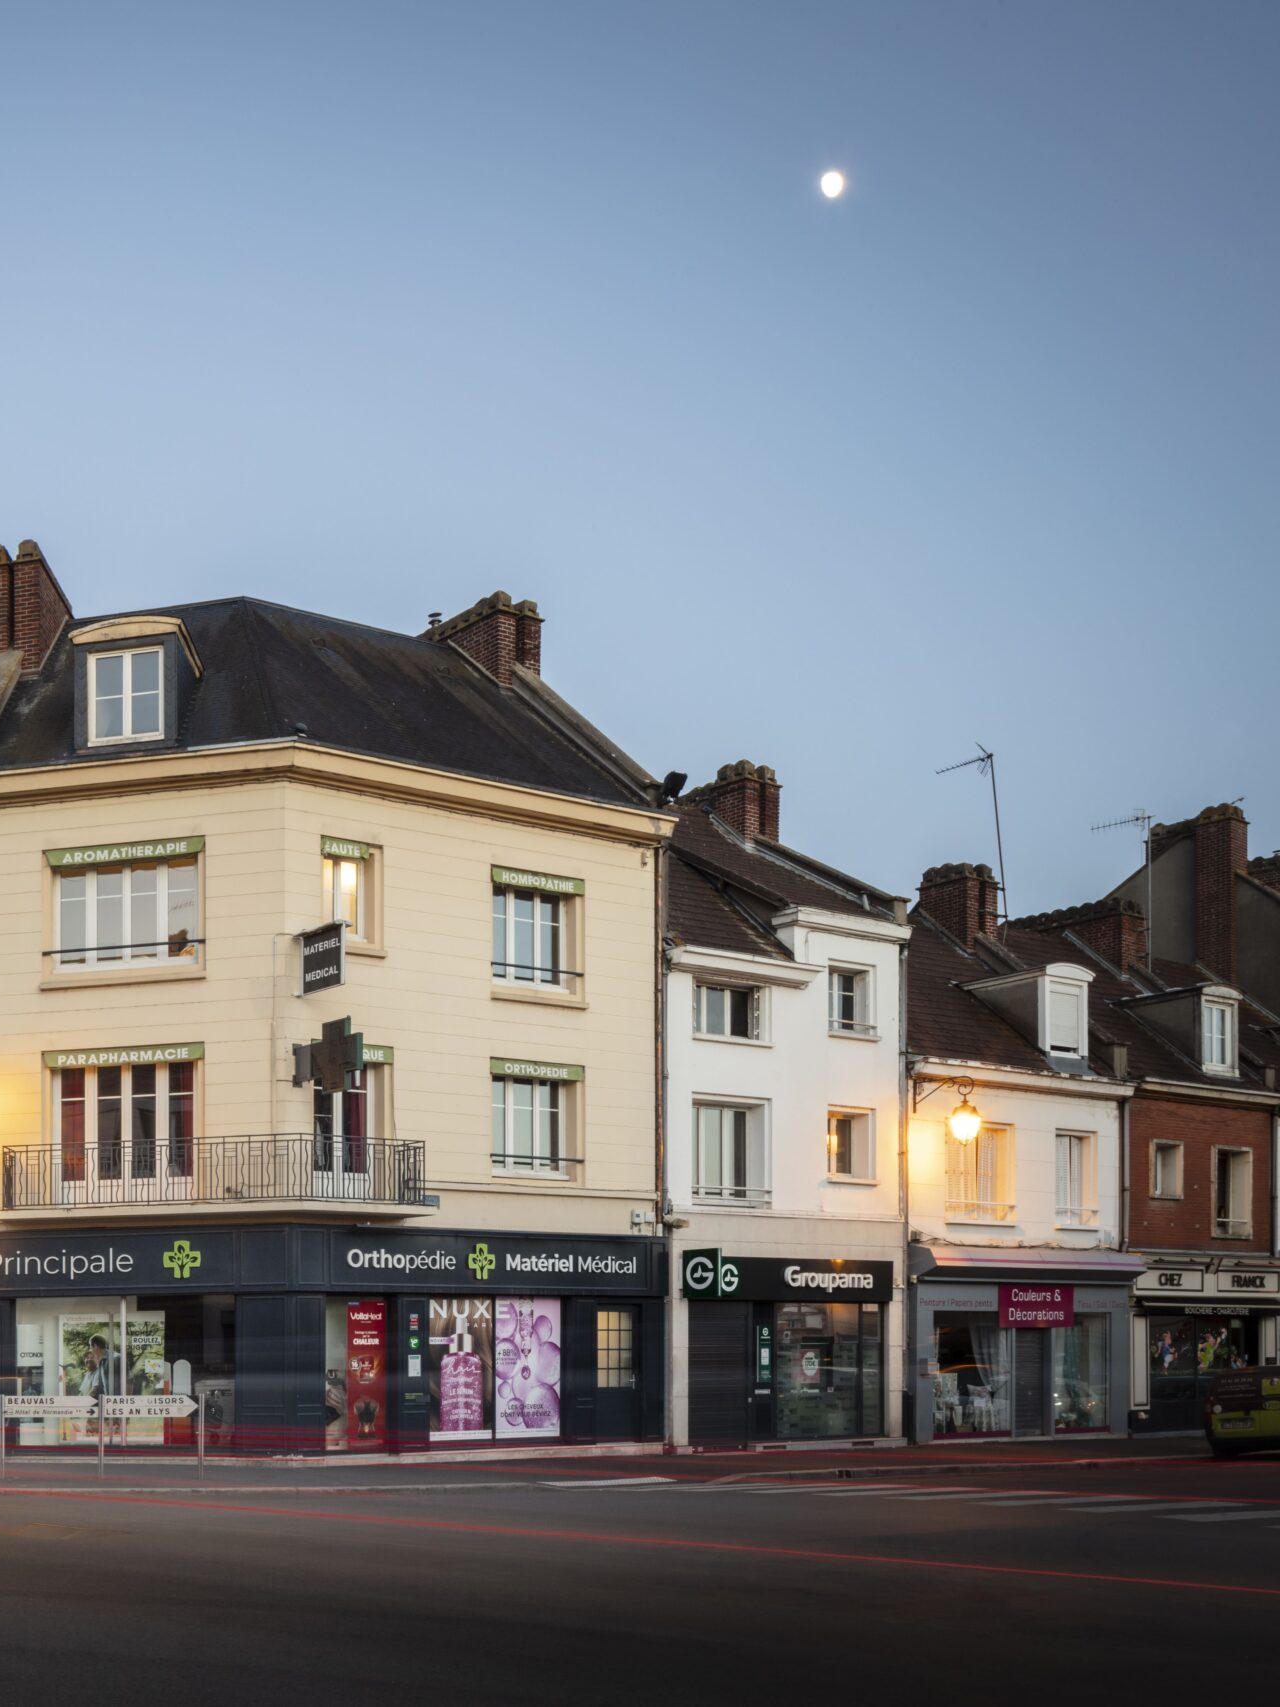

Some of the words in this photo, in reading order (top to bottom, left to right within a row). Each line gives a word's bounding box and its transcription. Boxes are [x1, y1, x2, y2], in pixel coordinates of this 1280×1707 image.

[62, 842, 187, 864] AROMATHERAPIE
[304, 938, 340, 956] MATERIEL
[306, 965, 338, 982] MEDICAL
[57, 1048, 188, 1065] PARAPHARMACIE
[505, 1063, 568, 1078] ORTHOPEDIE
[347, 1248, 456, 1274] Orthopédie
[505, 1253, 573, 1272] Matériel
[578, 1255, 636, 1274] Médical
[784, 1265, 873, 1293] Groupama
[1158, 1273, 1183, 1286] CHEZ
[1231, 1275, 1265, 1288] FRANCK
[1011, 1288, 1051, 1301] Couleurs
[1054, 1289, 1061, 1300] &
[1008, 1307, 1064, 1321] Décorations
[1184, 1307, 1213, 1315] BOUCHERIE
[7, 1397, 55, 1405] BEAUVAIS
